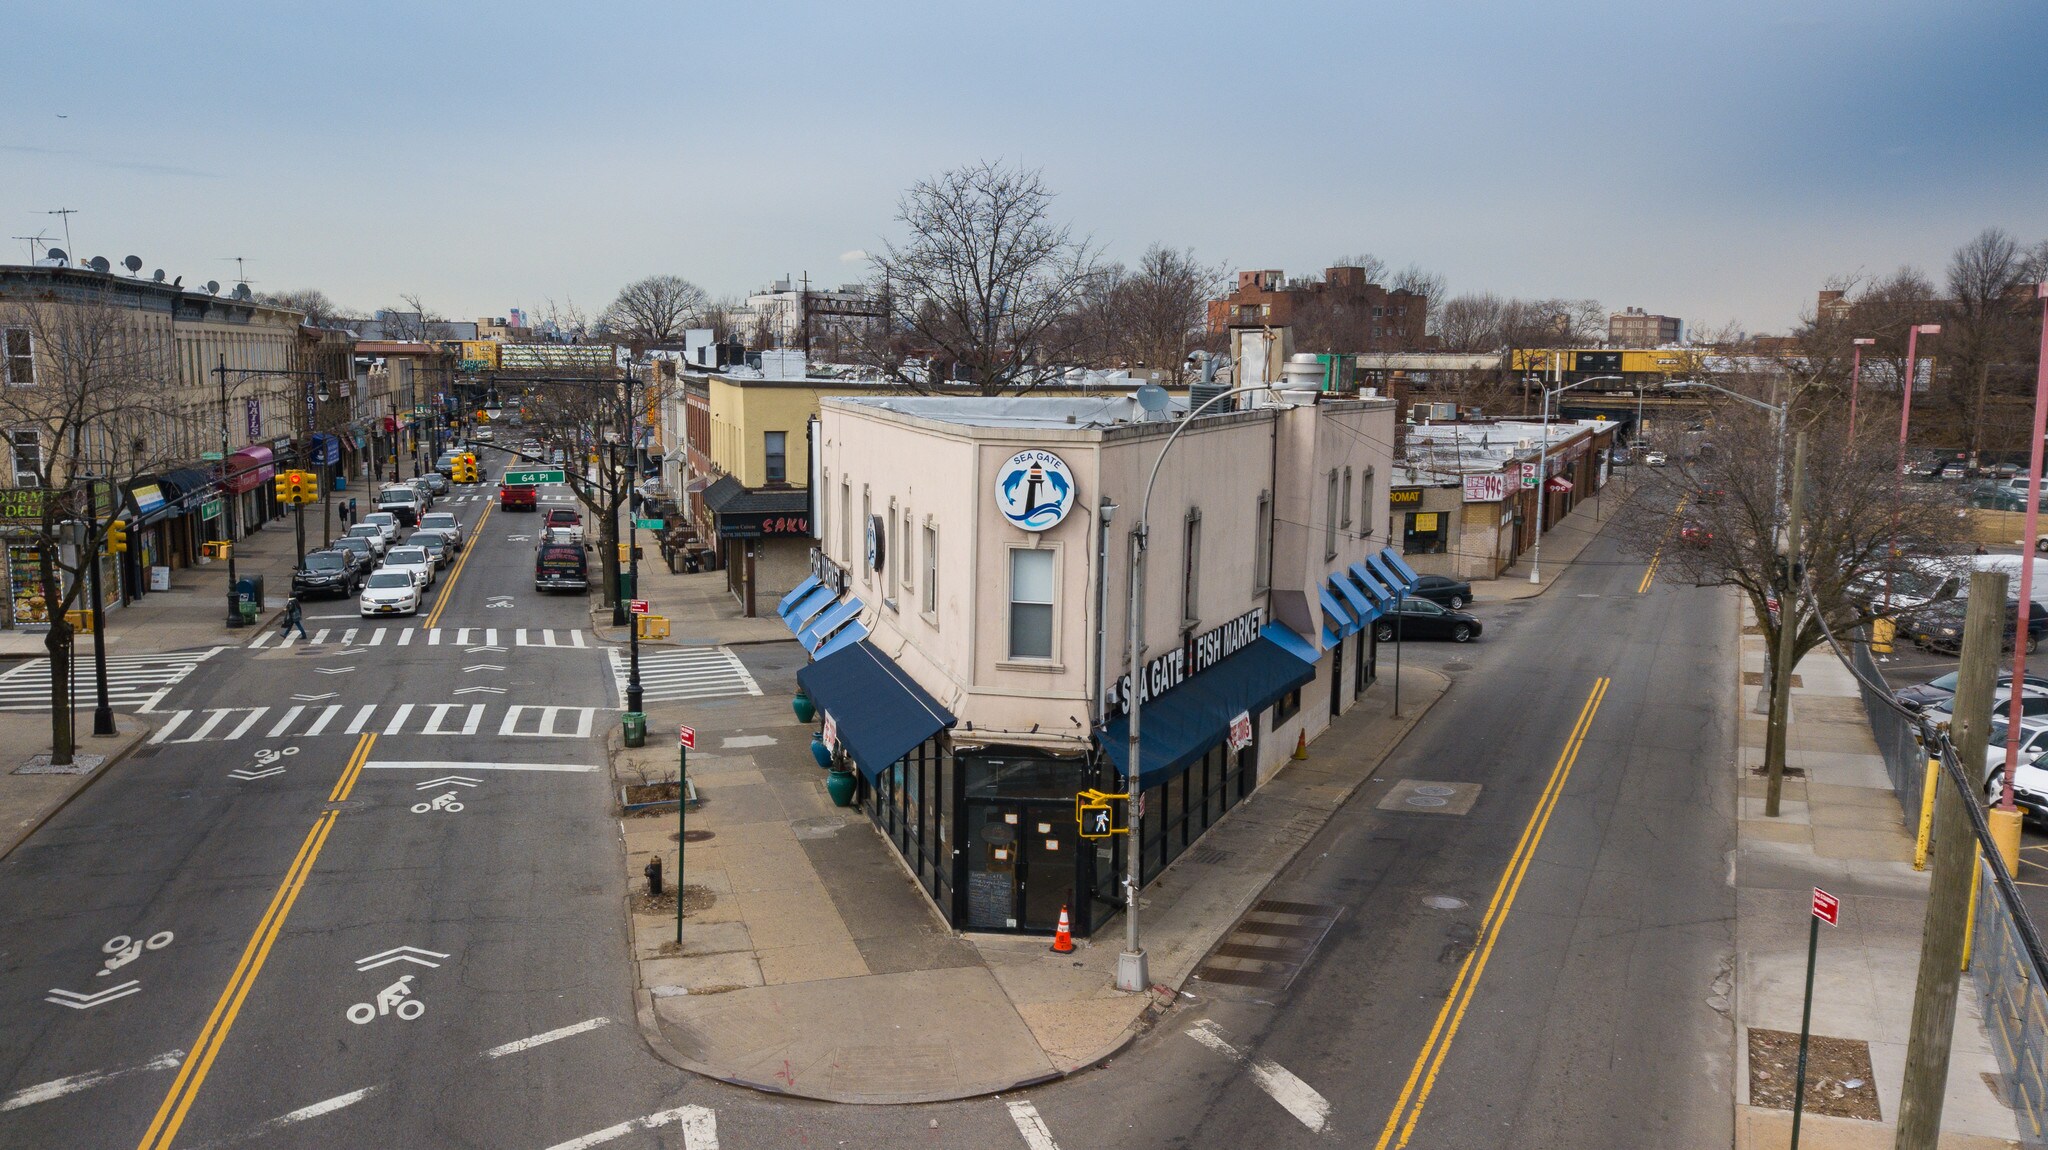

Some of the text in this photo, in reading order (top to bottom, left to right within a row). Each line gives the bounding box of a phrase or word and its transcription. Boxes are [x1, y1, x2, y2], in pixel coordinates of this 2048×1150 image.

[248, 400, 259, 435] NAILS
[1013, 452, 1062, 470] SEA GATE
[521, 473, 549, 482] 64 Pl
[1121, 608, 1263, 715] SA GATE FISH MARKET
